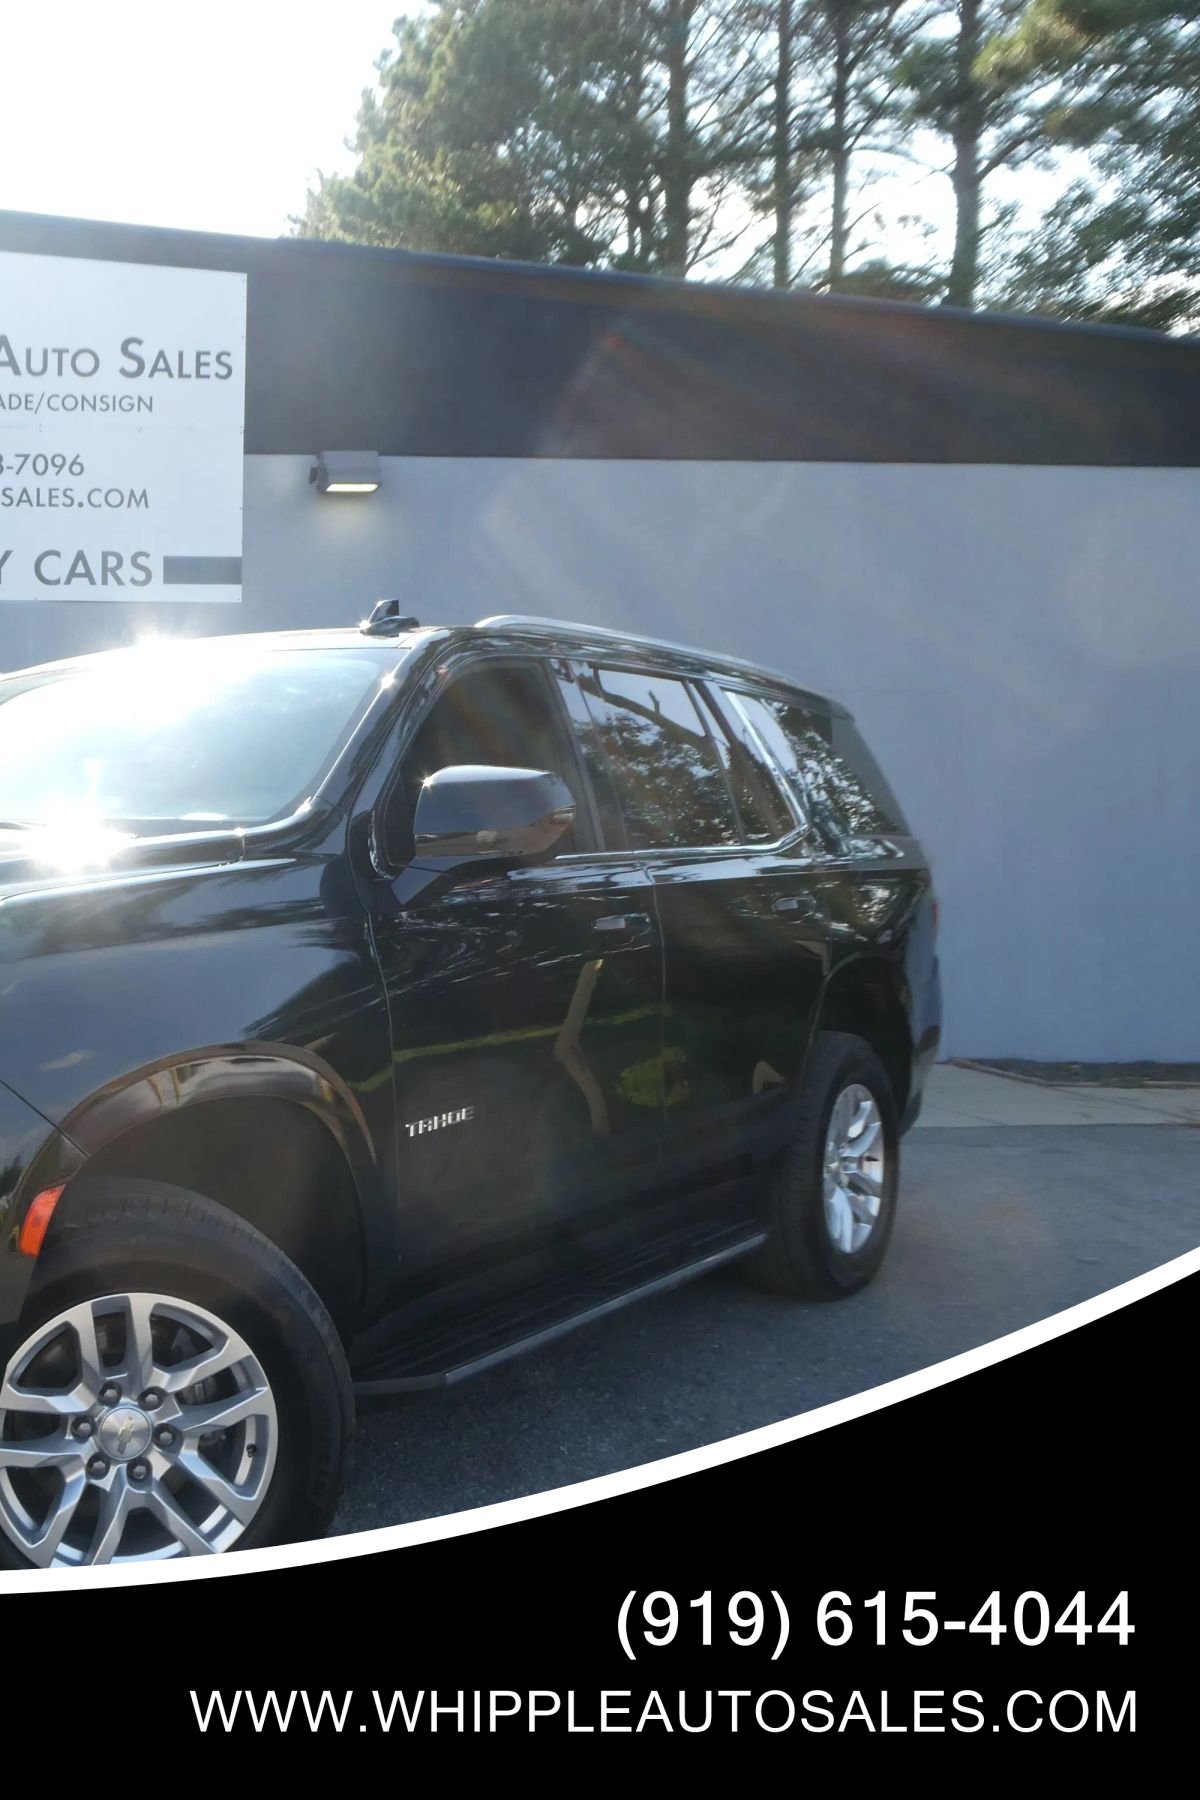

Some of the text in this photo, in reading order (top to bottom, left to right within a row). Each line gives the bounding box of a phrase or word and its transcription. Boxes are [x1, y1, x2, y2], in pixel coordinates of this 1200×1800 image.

[119, 337, 234, 380] SALES
[33, 549, 153, 587] CARS
[405, 1105, 475, 1138] TAHOE
